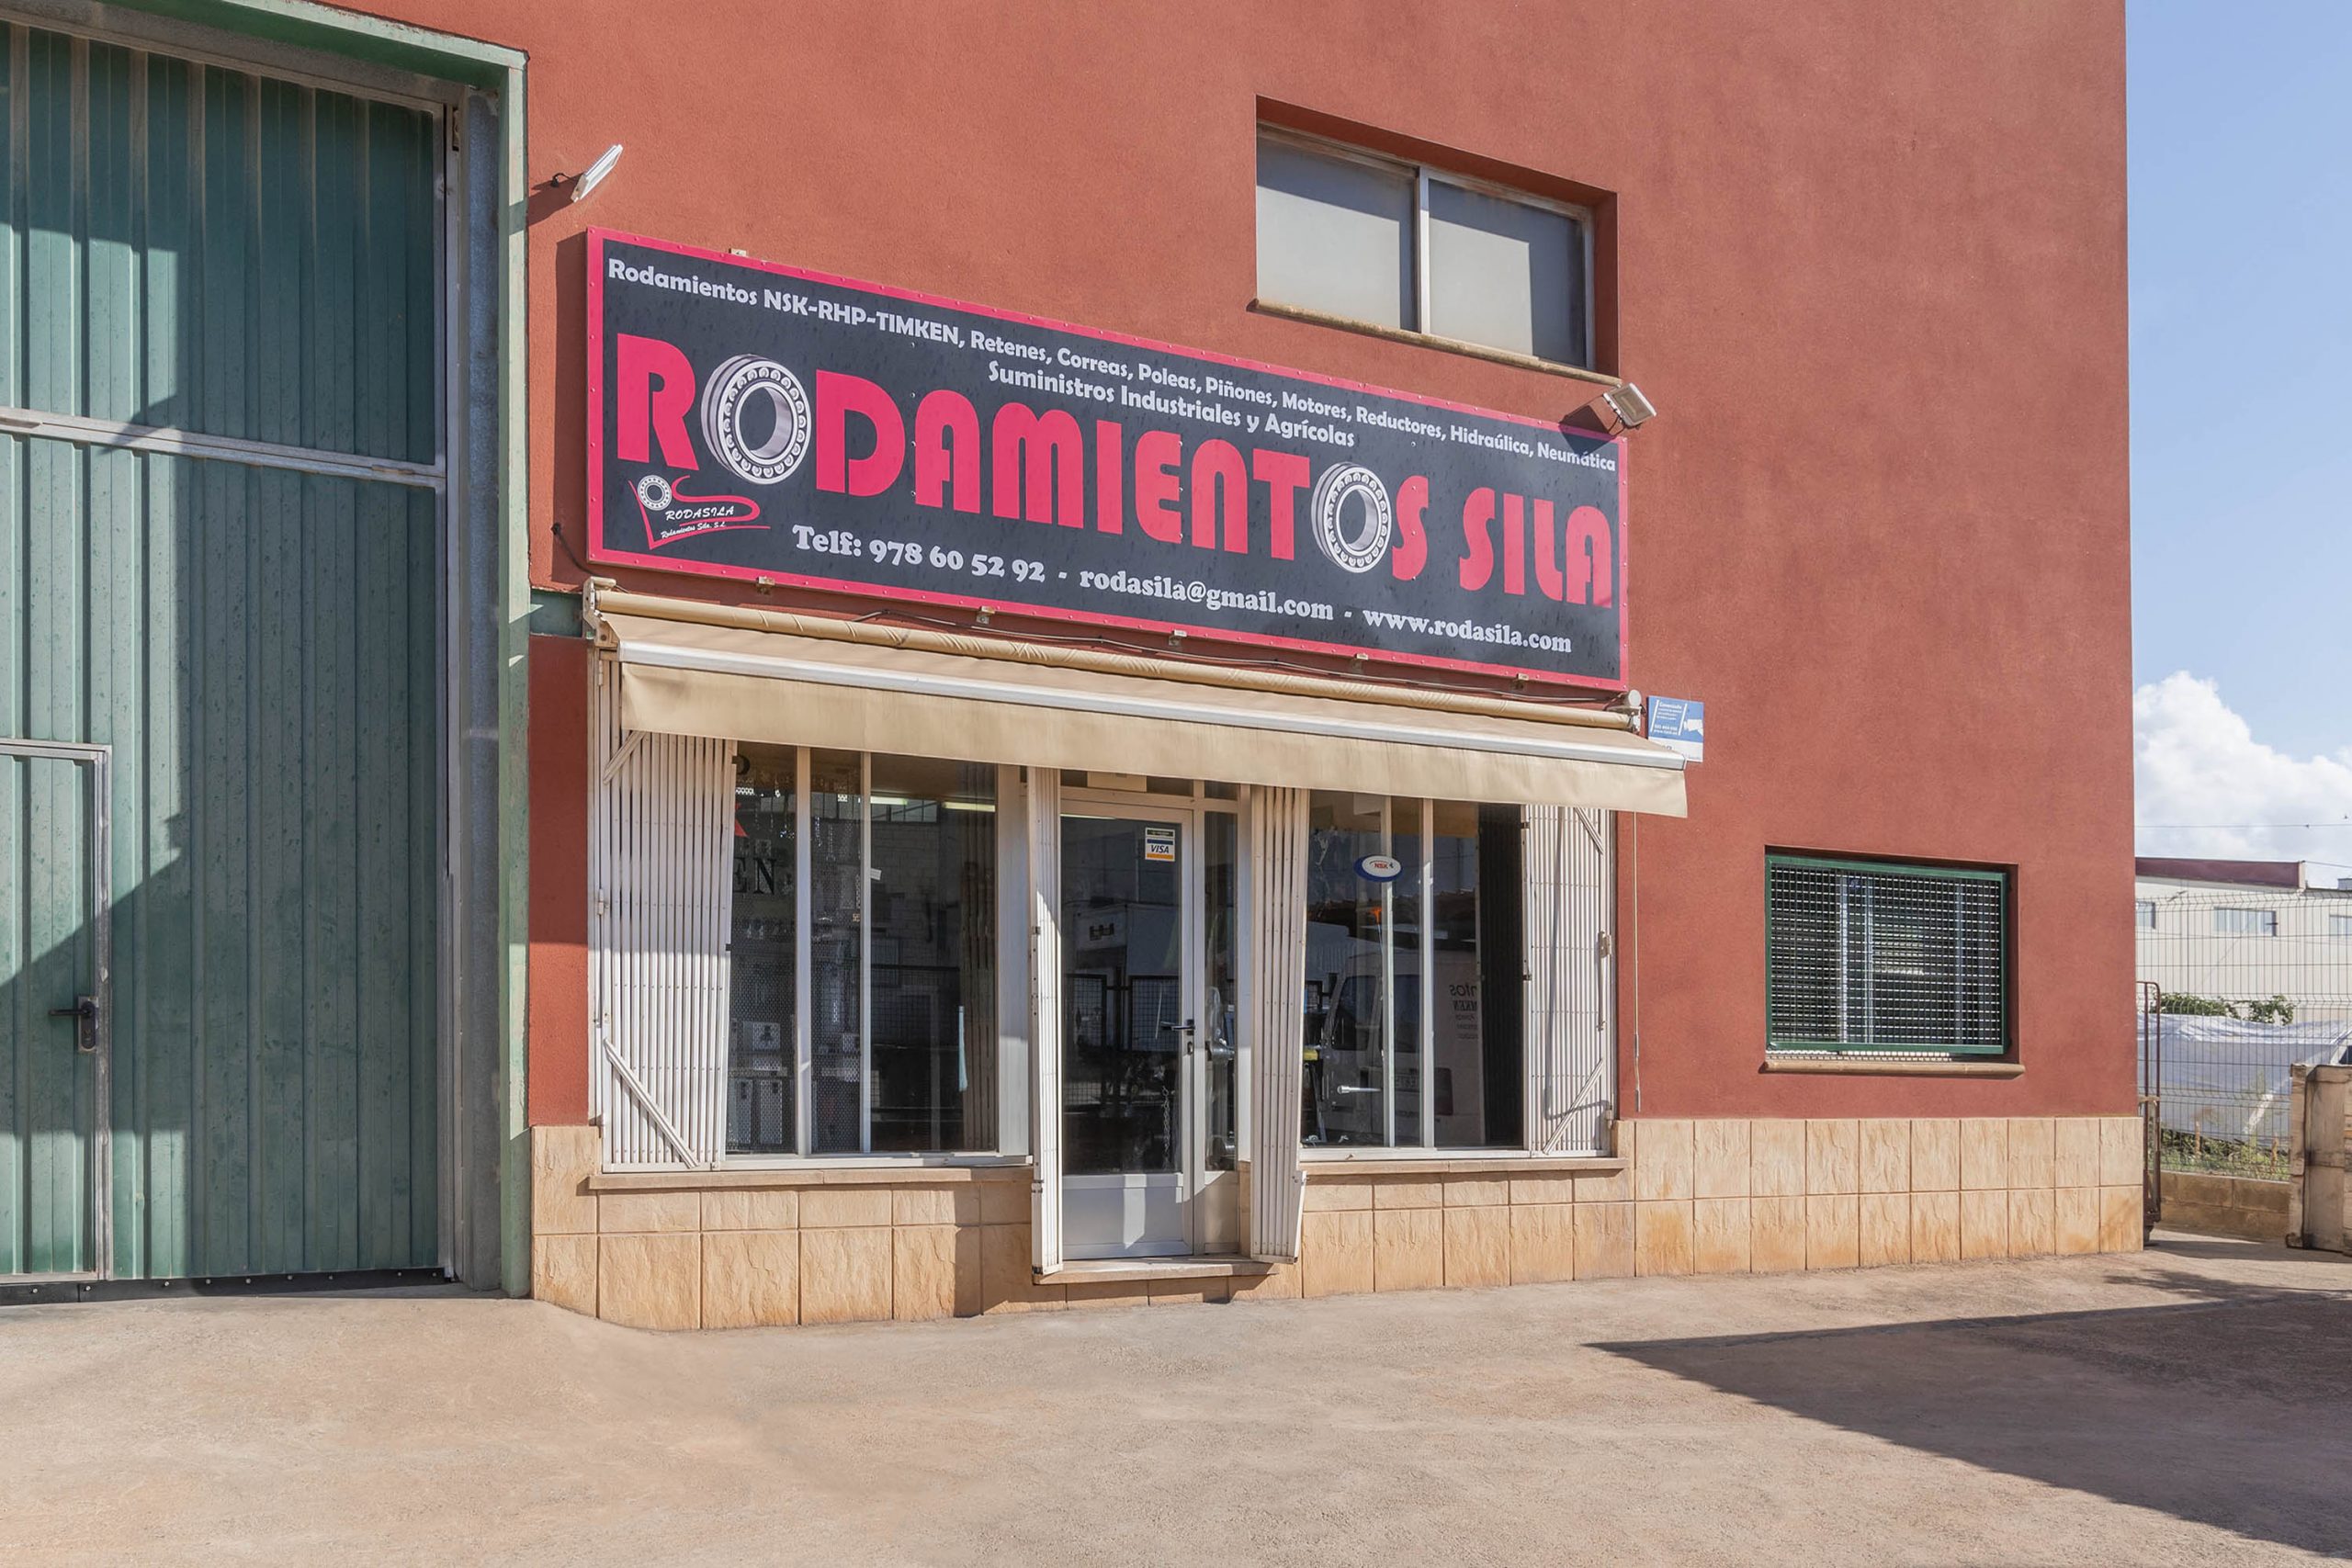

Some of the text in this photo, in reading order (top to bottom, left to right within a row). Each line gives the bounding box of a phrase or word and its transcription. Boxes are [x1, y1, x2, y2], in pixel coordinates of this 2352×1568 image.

[608, 257, 1617, 472] Rodamientos NSK-RHP-TIMKEN, Retenes, Correas, Poleas, Piñones, Motores, Reductores, Hidraúlica, Neumática
[988, 360, 1355, 448] Suministros Industriales y Agrícolas
[664, 505, 735, 521] RODASILA
[1459, 487, 1612, 608] SILA
[792, 524, 862, 557] Telf:
[868, 539, 923, 567] 978
[929, 545, 964, 570] 60
[970, 553, 1005, 578] 52
[1012, 558, 1046, 583] 92
[1080, 570, 1334, 621] rodasila@gmail.com
[1362, 609, 1572, 653] www.rodasila.com
[1150, 844, 1170, 854] VISA
